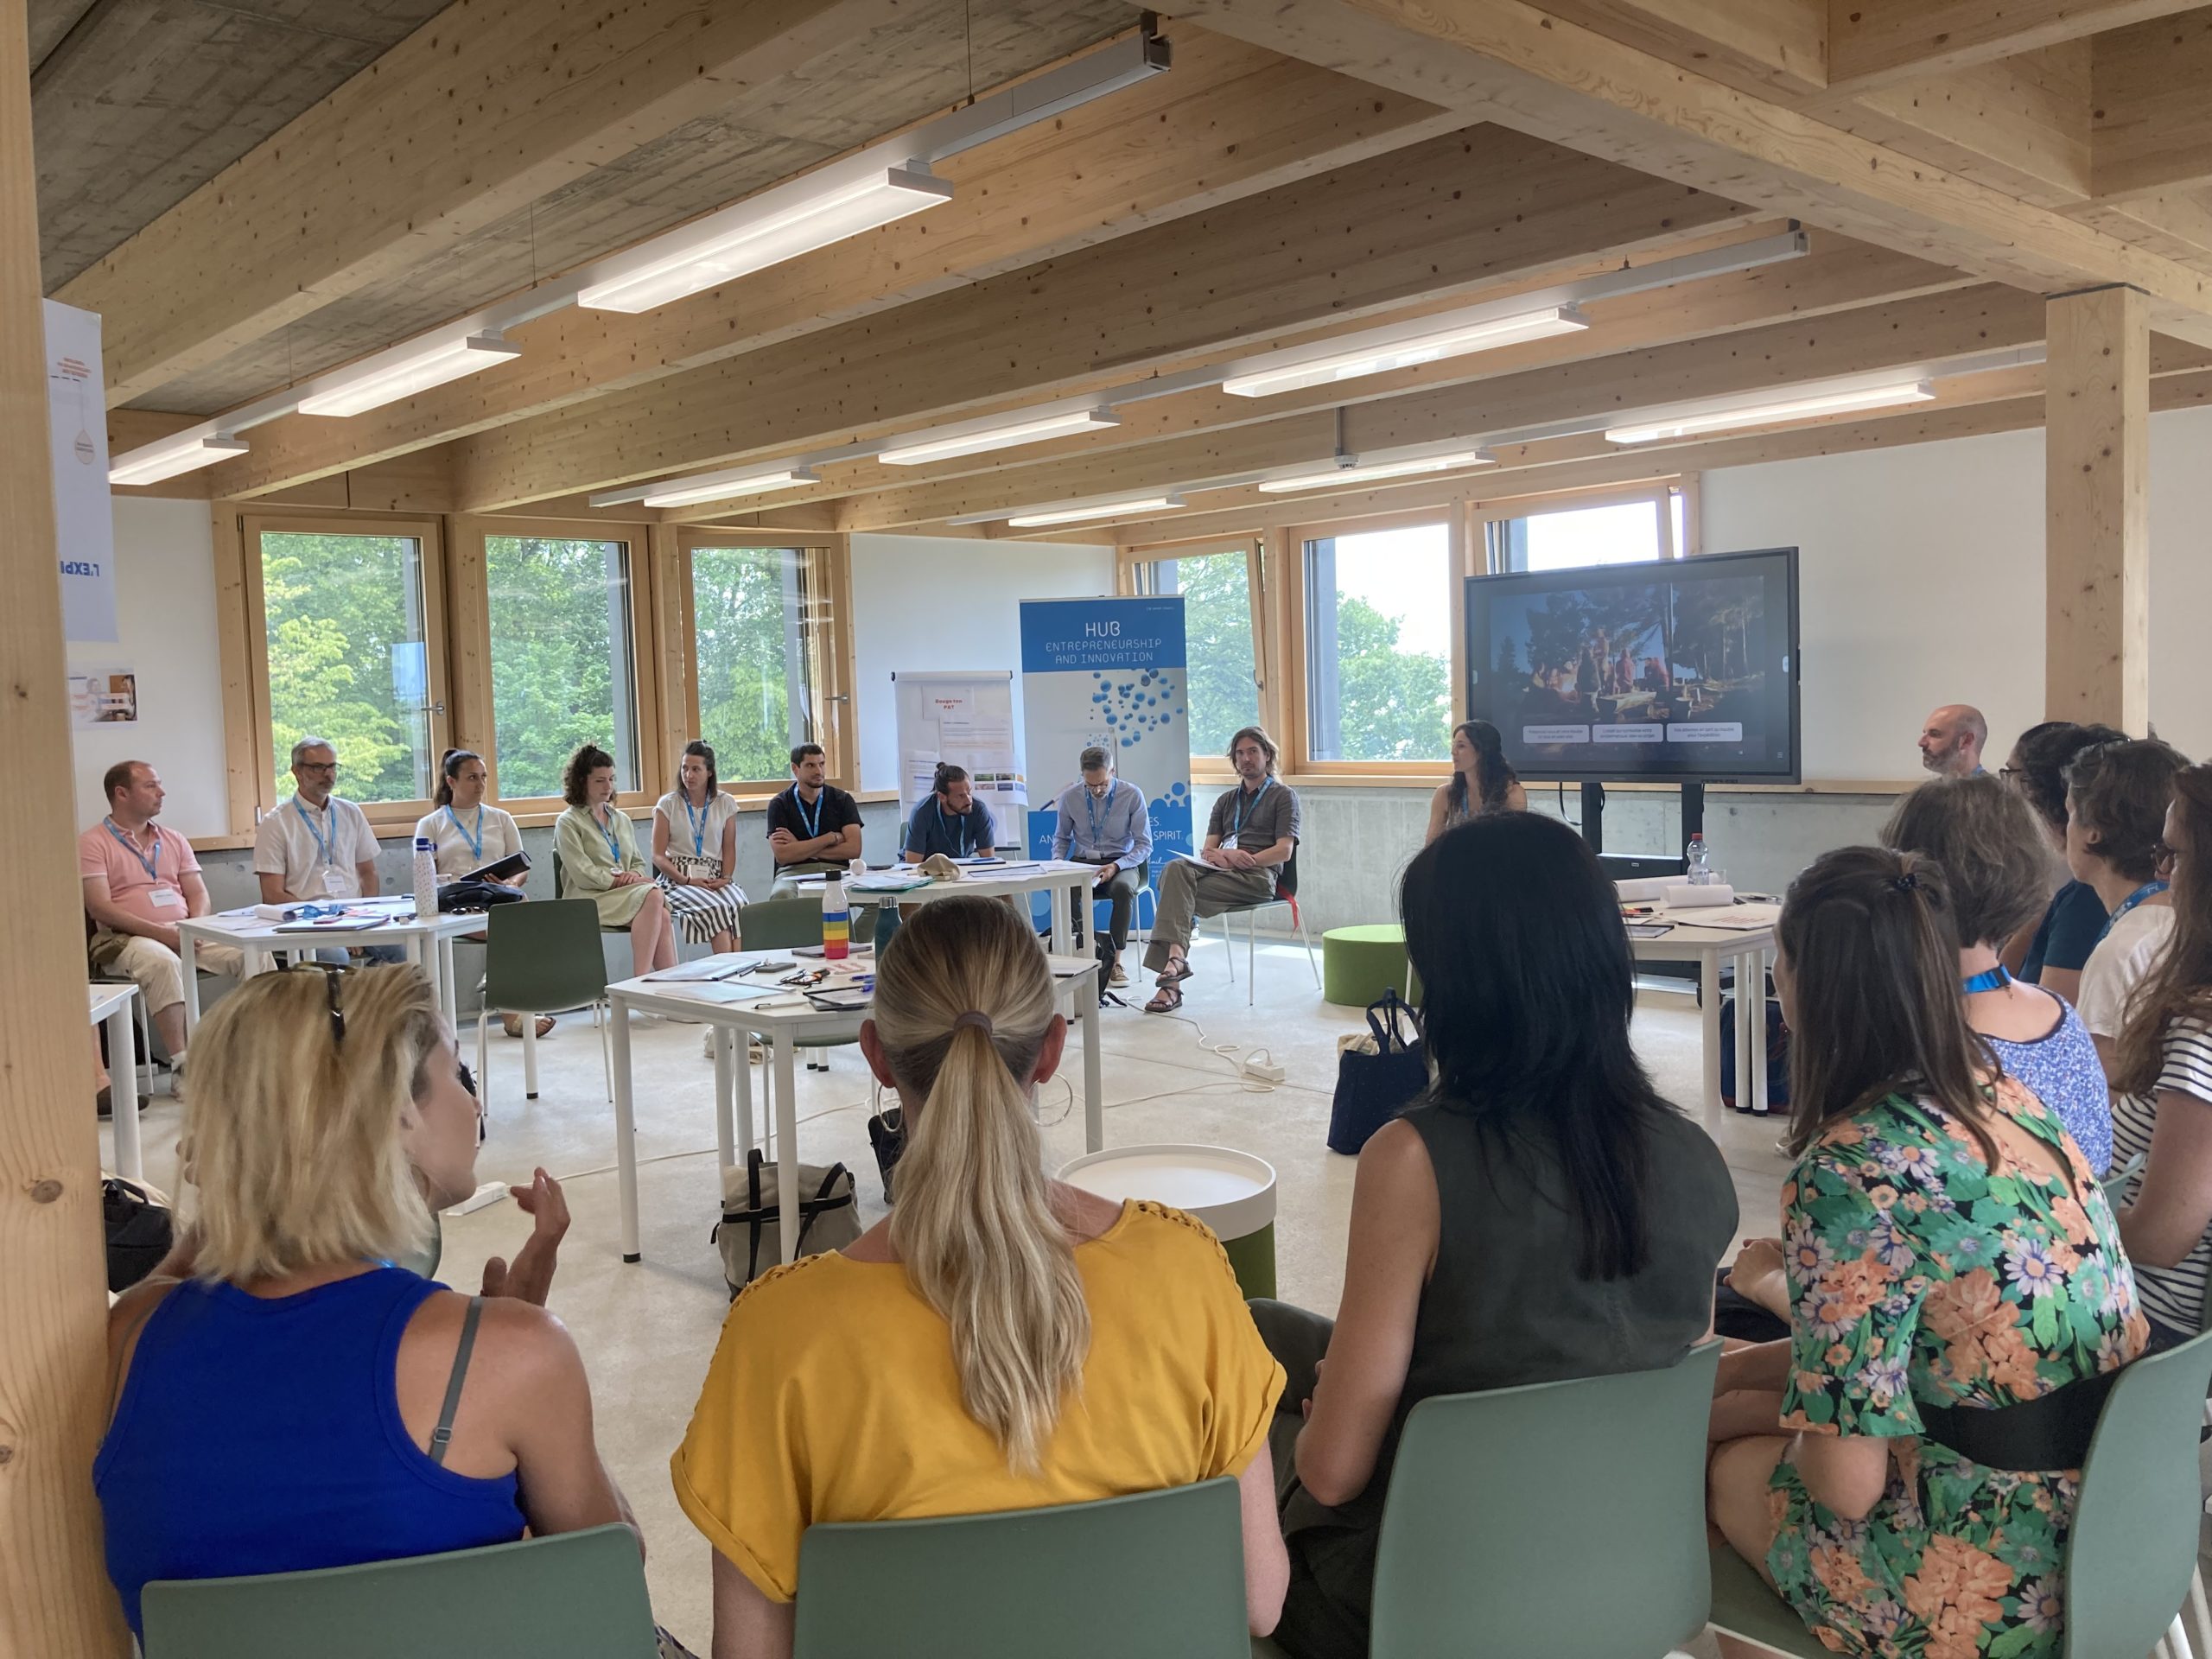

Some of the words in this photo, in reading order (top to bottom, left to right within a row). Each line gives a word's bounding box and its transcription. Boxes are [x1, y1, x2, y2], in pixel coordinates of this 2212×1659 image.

[1085, 620, 1121, 637] HUB
[1046, 638, 1162, 652] ENTREPRENEURSHIP
[1055, 654, 1077, 664] AND
[1081, 652, 1154, 664] INNOVATION
[1148, 817, 1161, 827] ES.
[1039, 834, 1054, 844] AN
